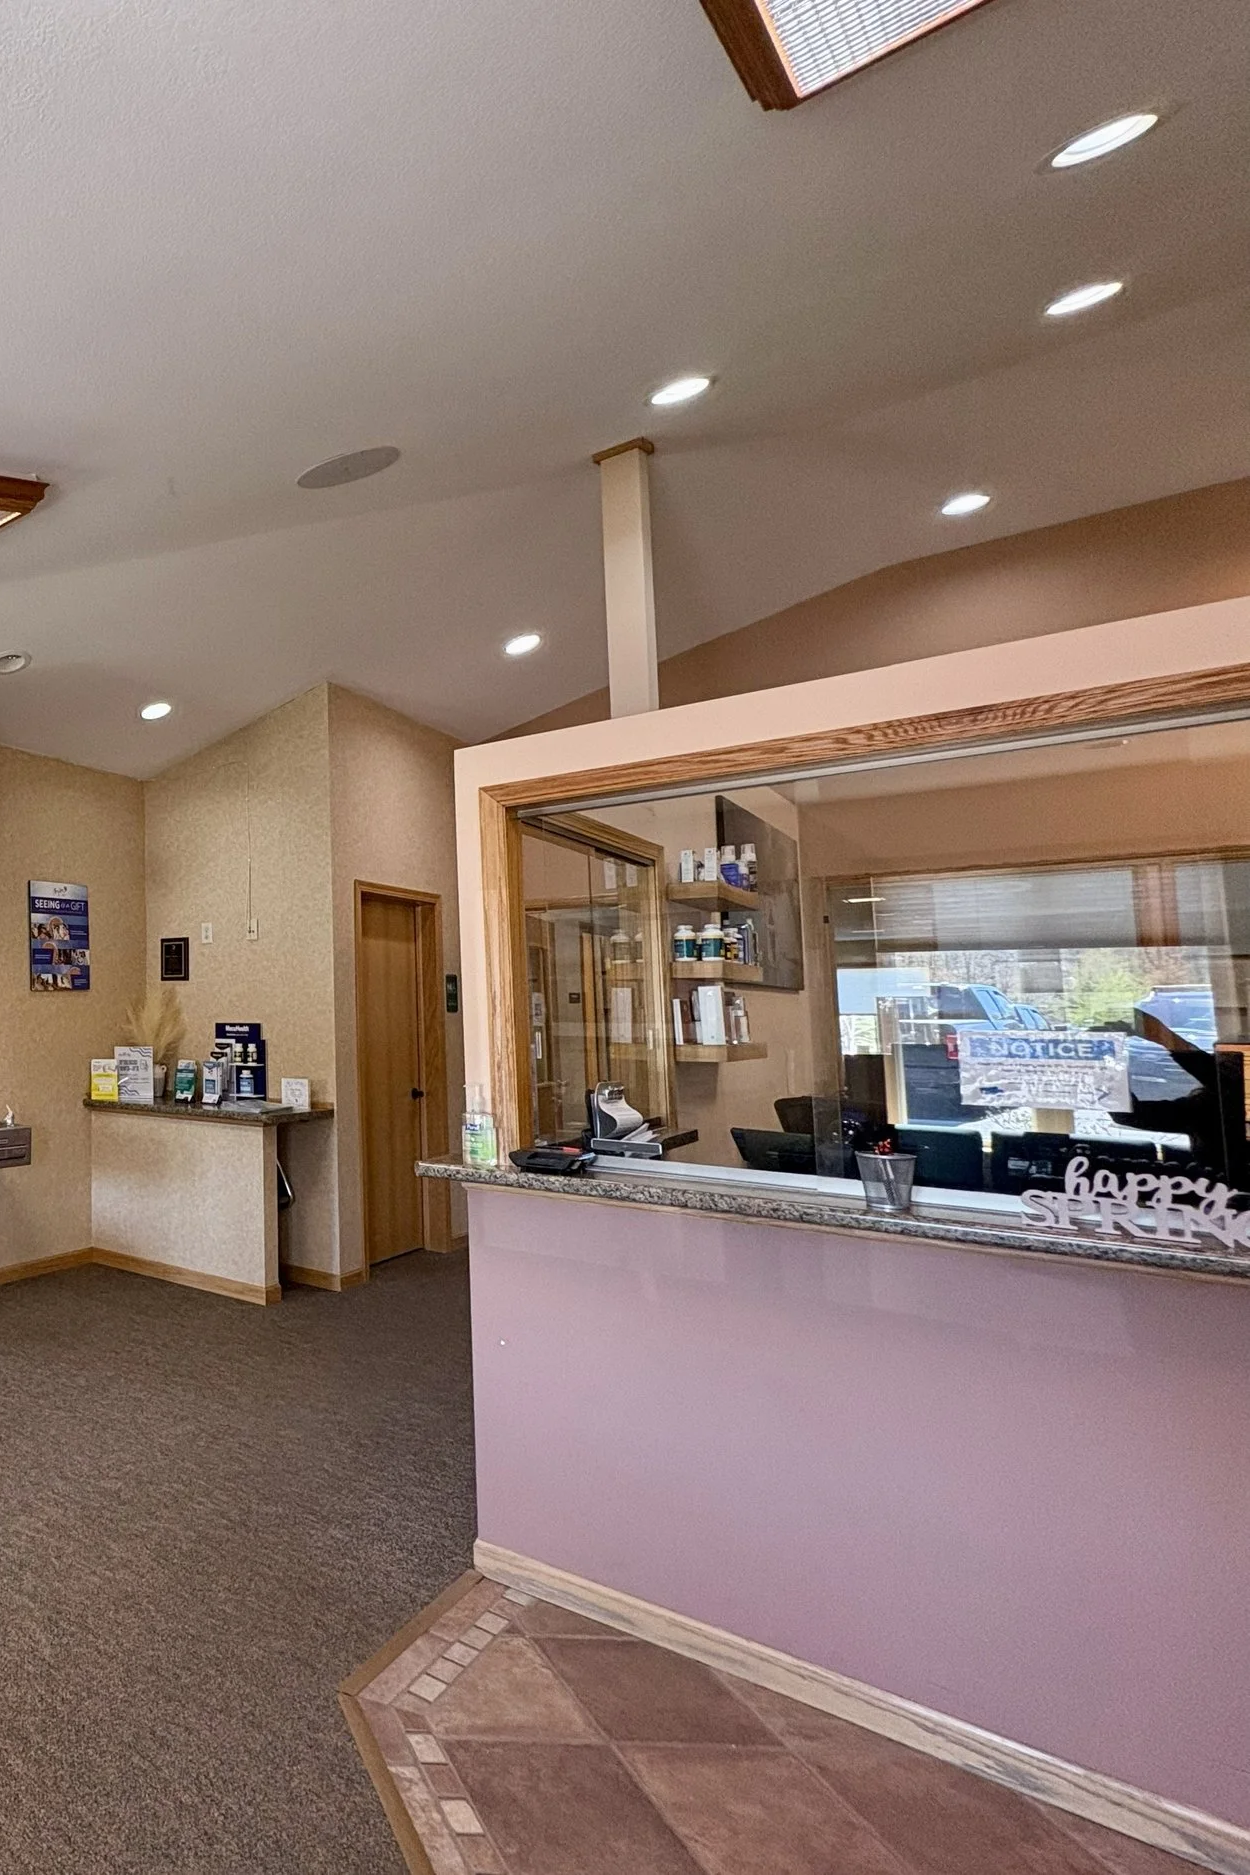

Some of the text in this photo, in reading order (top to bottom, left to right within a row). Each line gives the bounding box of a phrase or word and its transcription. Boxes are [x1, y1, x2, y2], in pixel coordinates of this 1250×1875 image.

[34, 899, 60, 910] SEEING
[70, 901, 85, 911] GIFT
[990, 1040, 1094, 1058] NOTICE
[1063, 1155, 1238, 1221] happy
